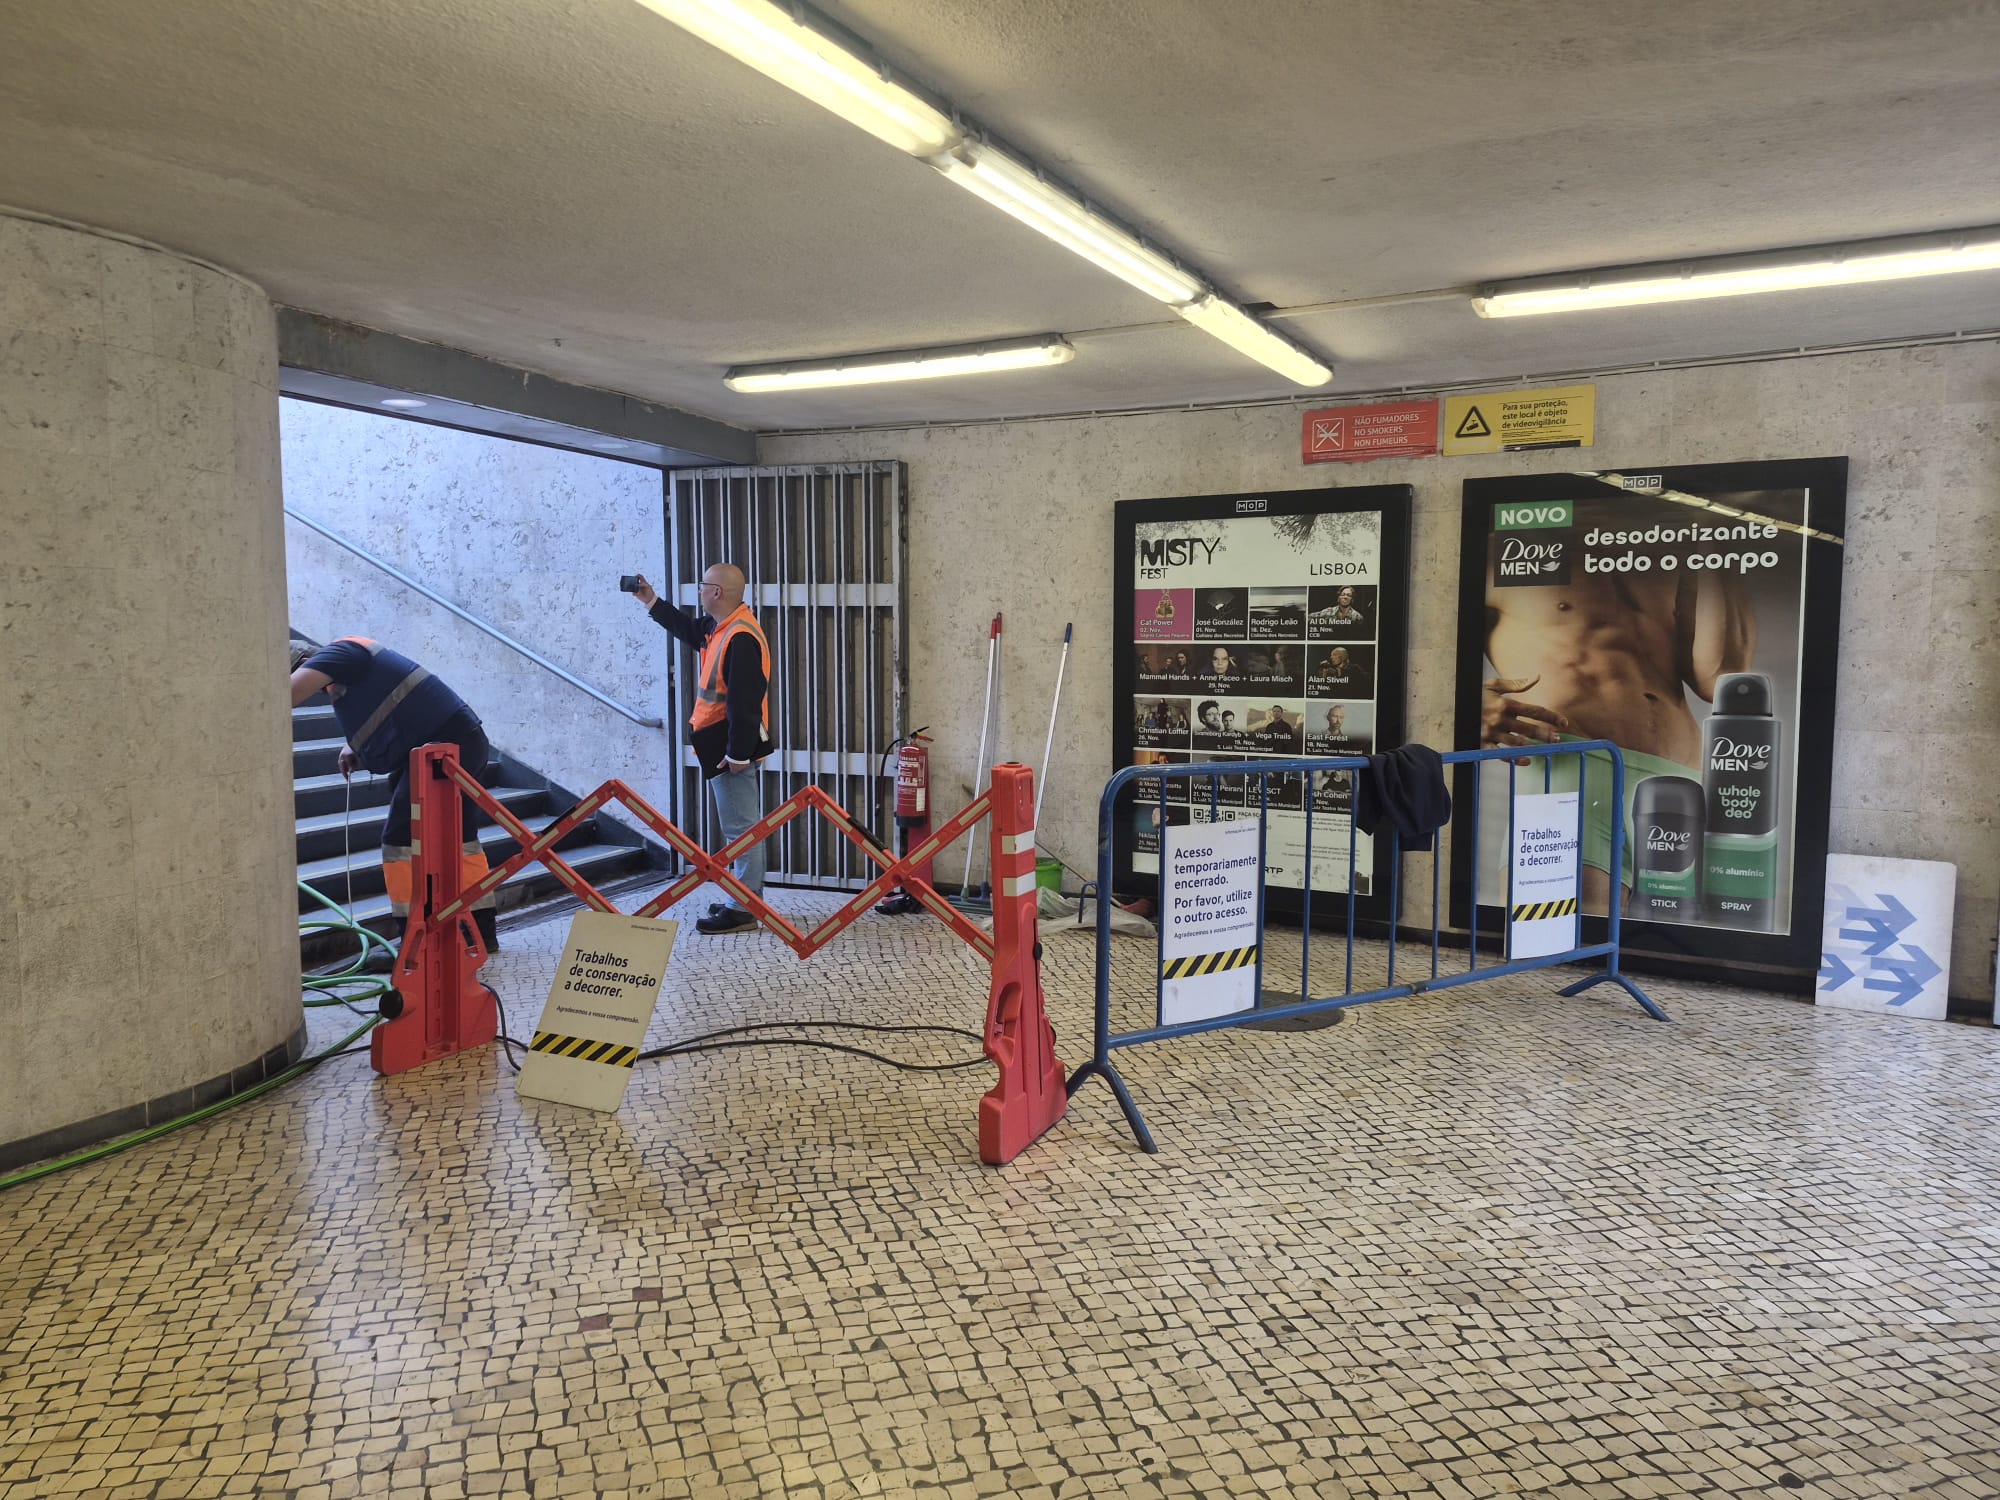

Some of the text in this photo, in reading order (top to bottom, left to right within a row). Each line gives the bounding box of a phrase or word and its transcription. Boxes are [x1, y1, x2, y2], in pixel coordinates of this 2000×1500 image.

[1502, 402, 1518, 411] Para
[1533, 400, 1568, 410] proteção,
[1354, 412, 1420, 426] NÃO FUMADORES
[1502, 412, 1518, 420] este
[1519, 409, 1536, 418] local
[1544, 408, 1568, 418] objeto
[1354, 424, 1404, 436] NO SMOKERS
[1502, 418, 1567, 429] de videovigilância
[1354, 435, 1409, 447] NON FUMEURS
[1624, 478, 1659, 488] MOP
[1238, 502, 1265, 511] MOP
[1501, 507, 1567, 526] NOVO
[1584, 521, 1778, 547] desodorizante
[1141, 537, 1221, 566] MISTY
[1501, 537, 1564, 561] Dove
[1500, 560, 1540, 576] MEN
[1584, 550, 1779, 574] todo o corpo
[1140, 568, 1168, 580] FEST
[1310, 562, 1368, 576] LISBOA
[1196, 618, 1244, 626] José González
[1251, 618, 1298, 628] Rodrigo Leão
[1329, 618, 1352, 626] Meola
[1308, 676, 1349, 684] Alan Stivell
[1256, 732, 1272, 740] Vega
[1325, 734, 1348, 742] Forest
[1712, 736, 1772, 759] Dove
[1710, 758, 1749, 772] MEN
[1220, 784, 1244, 793] Peirani
[1718, 785, 1761, 798] whole
[1324, 792, 1348, 800] Cohen
[1721, 796, 1757, 812] body
[1725, 806, 1753, 819] deo
[1521, 827, 1562, 840] Trabalhos
[1648, 825, 1690, 843] Dove
[1520, 839, 1579, 854] de conservação
[1646, 840, 1674, 852] MEN
[1174, 847, 1213, 859] Acesso
[1174, 855, 1257, 876] temporariamente
[1520, 854, 1562, 867] a decorrer.
[1710, 866, 1765, 878] 0% alumínio
[1174, 874, 1229, 890] encerrado.
[1174, 888, 1253, 910] Por favor, utilize
[1651, 898, 1678, 909] STICK
[1721, 902, 1752, 912] SPRAY
[1174, 905, 1248, 924] o outro acesso.
[1174, 930, 1209, 940] Agradecemos
[575, 949, 629, 968] Trabalhos
[569, 964, 656, 988] de conservação
[564, 978, 624, 998] a decorrer.
[556, 1005, 588, 1016] Agradecemos
